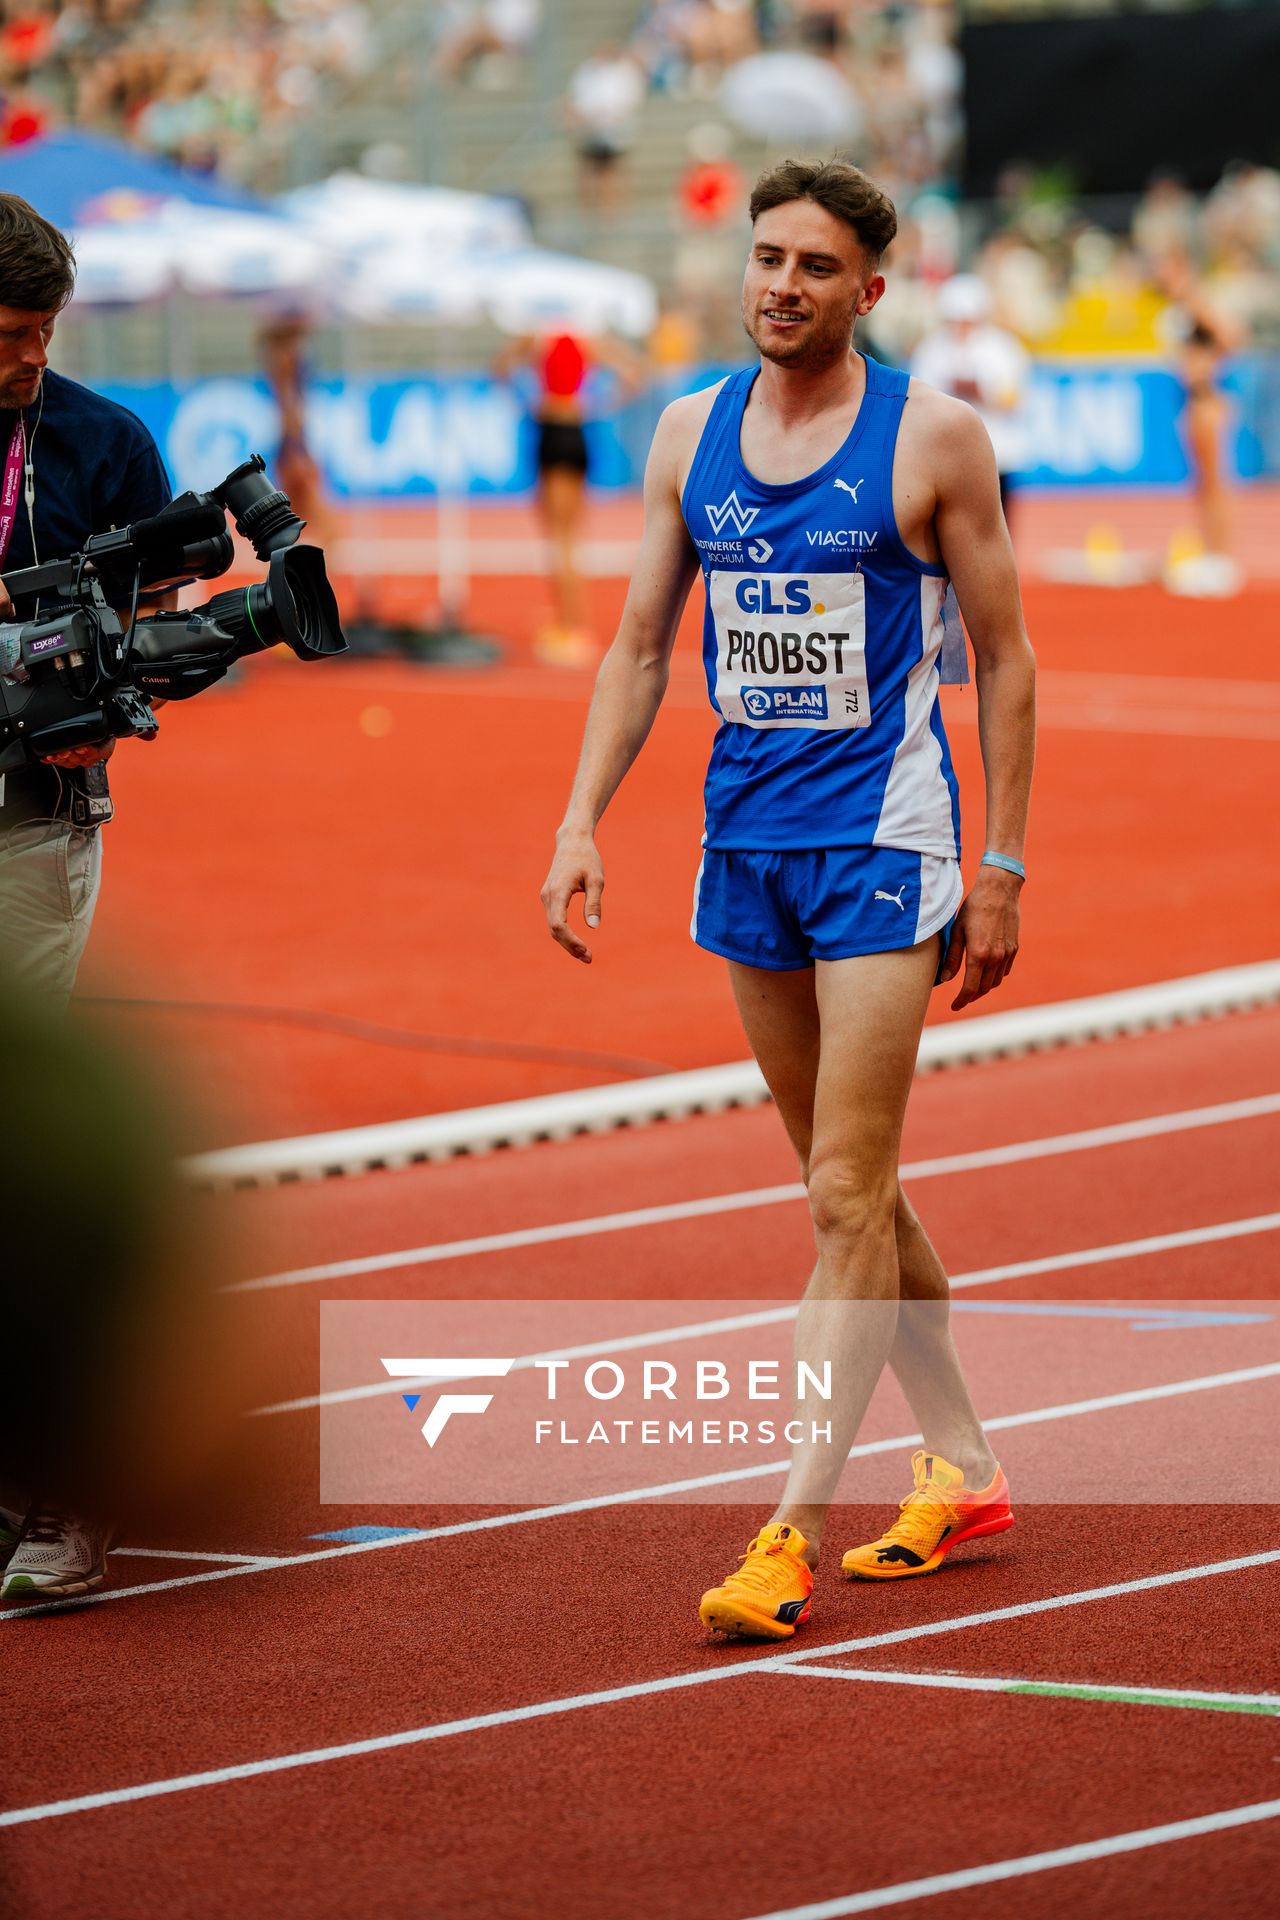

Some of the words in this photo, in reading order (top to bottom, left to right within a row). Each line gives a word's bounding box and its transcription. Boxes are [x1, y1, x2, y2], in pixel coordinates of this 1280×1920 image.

[805, 530, 878, 546] VIACTIV
[726, 630, 850, 675] PROBST
[141, 676, 170, 684] Canon
[773, 691, 823, 708] PLAN
[844, 689, 859, 714] 772
[776, 708, 824, 716] INTERNATIONAL
